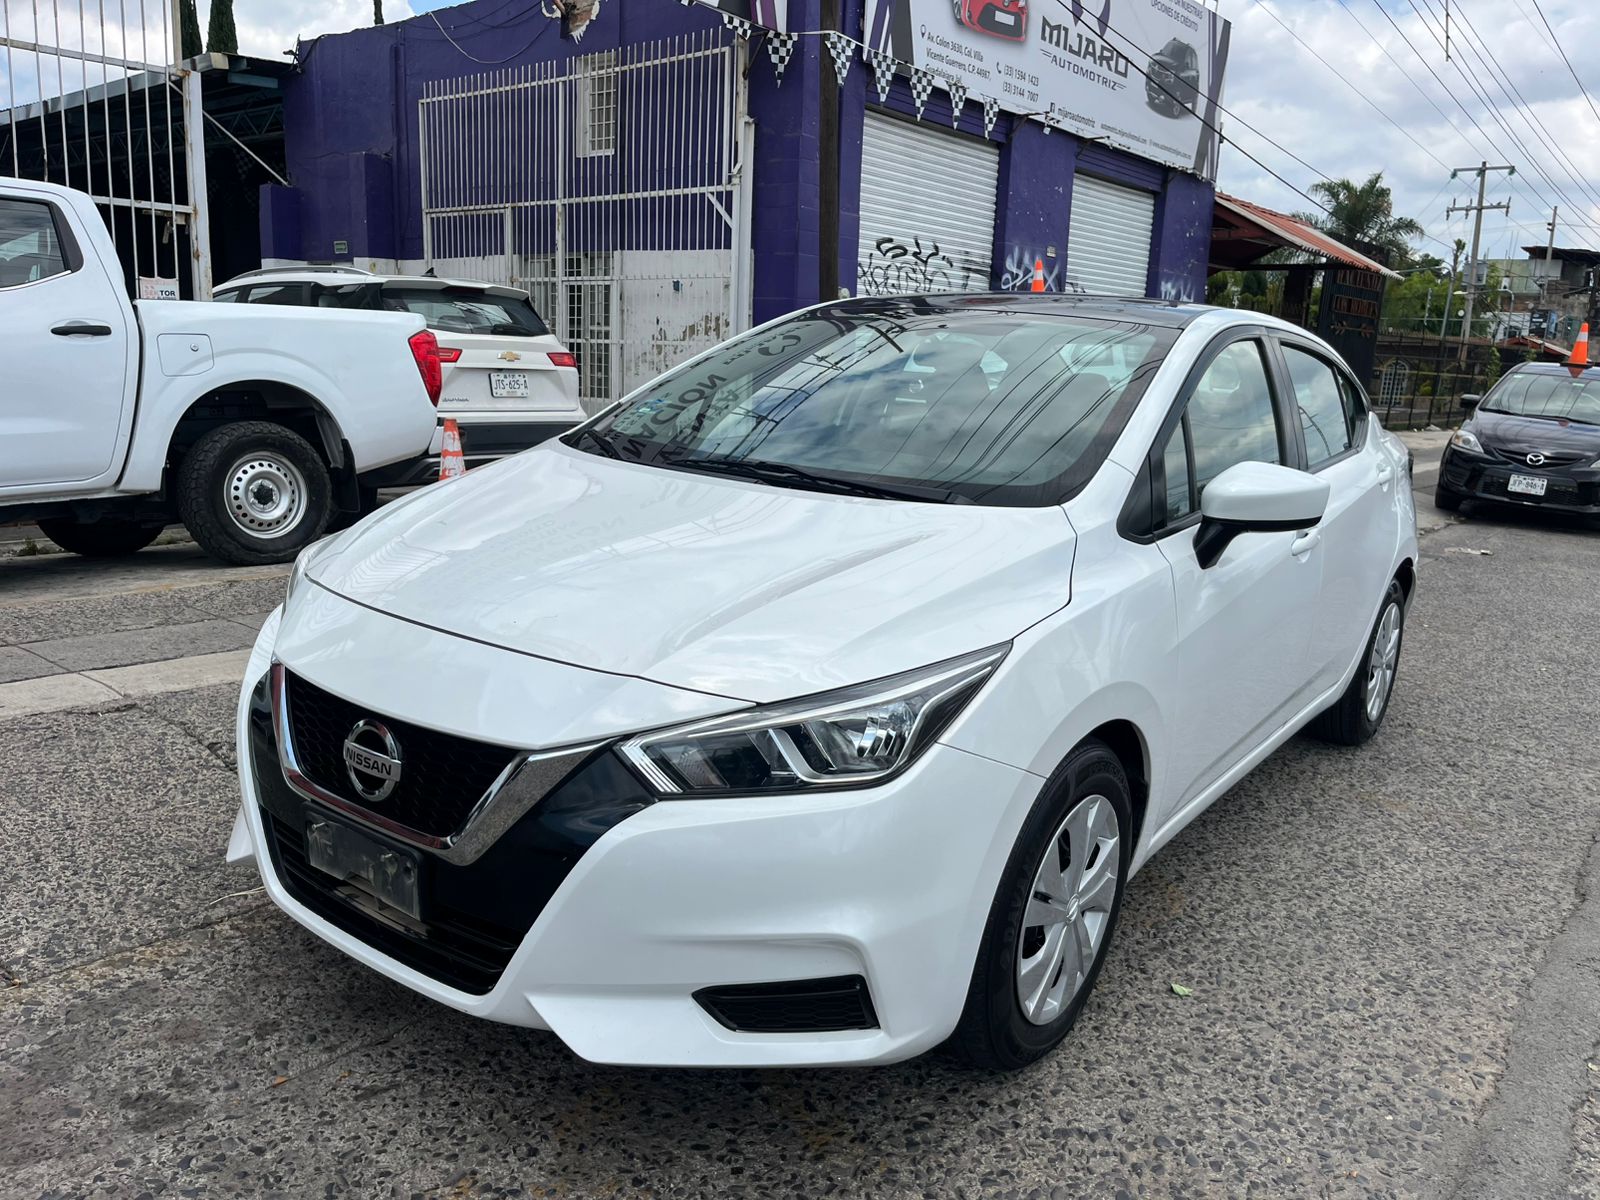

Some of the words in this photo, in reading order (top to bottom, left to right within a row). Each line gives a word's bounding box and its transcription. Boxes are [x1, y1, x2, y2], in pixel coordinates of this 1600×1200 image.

[926, 47, 945, 63] Vicente
[1041, 16, 1129, 79] MIJARO
[1004, 63, 1014, 78] (33)
[1051, 55, 1118, 91] AUTOMOTRIZ
[1003, 81, 1012, 95] (33)
[346, 746, 392, 776] NISSAN
